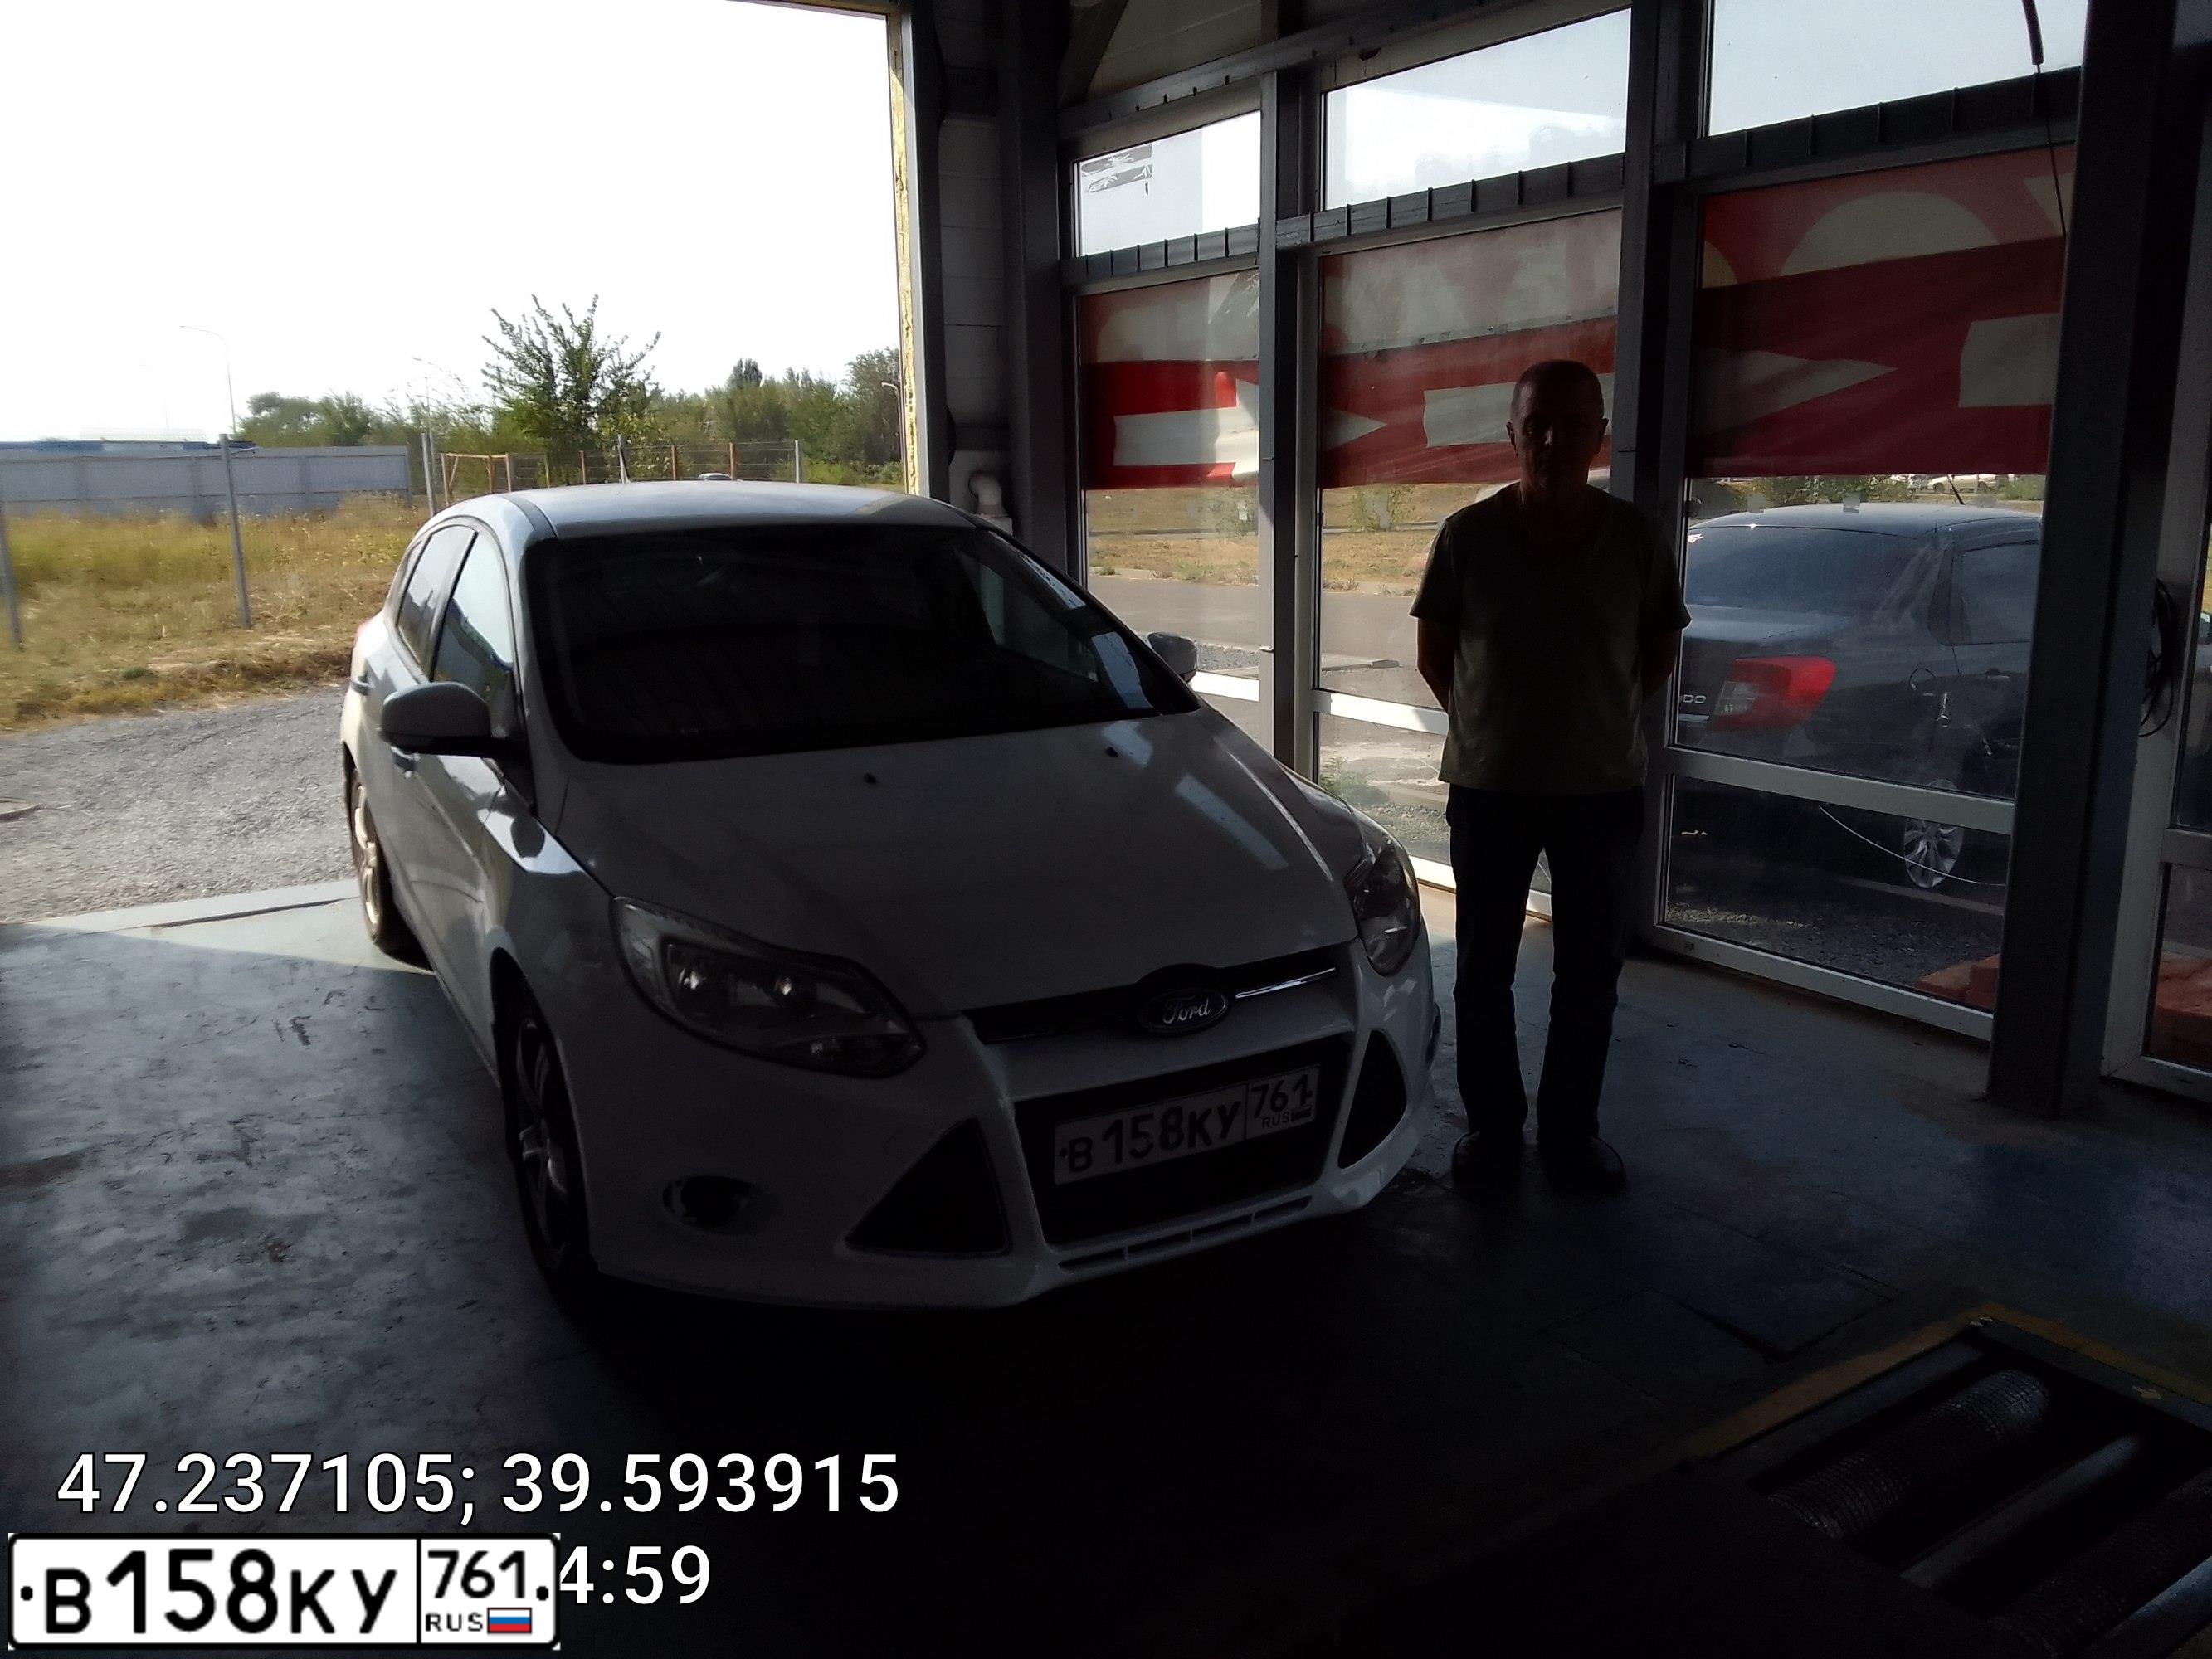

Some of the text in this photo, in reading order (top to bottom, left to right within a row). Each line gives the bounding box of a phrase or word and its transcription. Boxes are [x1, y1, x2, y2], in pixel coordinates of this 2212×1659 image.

[1162, 996, 1211, 1024] Ford
[1068, 1073, 1310, 1173] В158КУ 761
[1261, 1111, 1290, 1129] RUS
